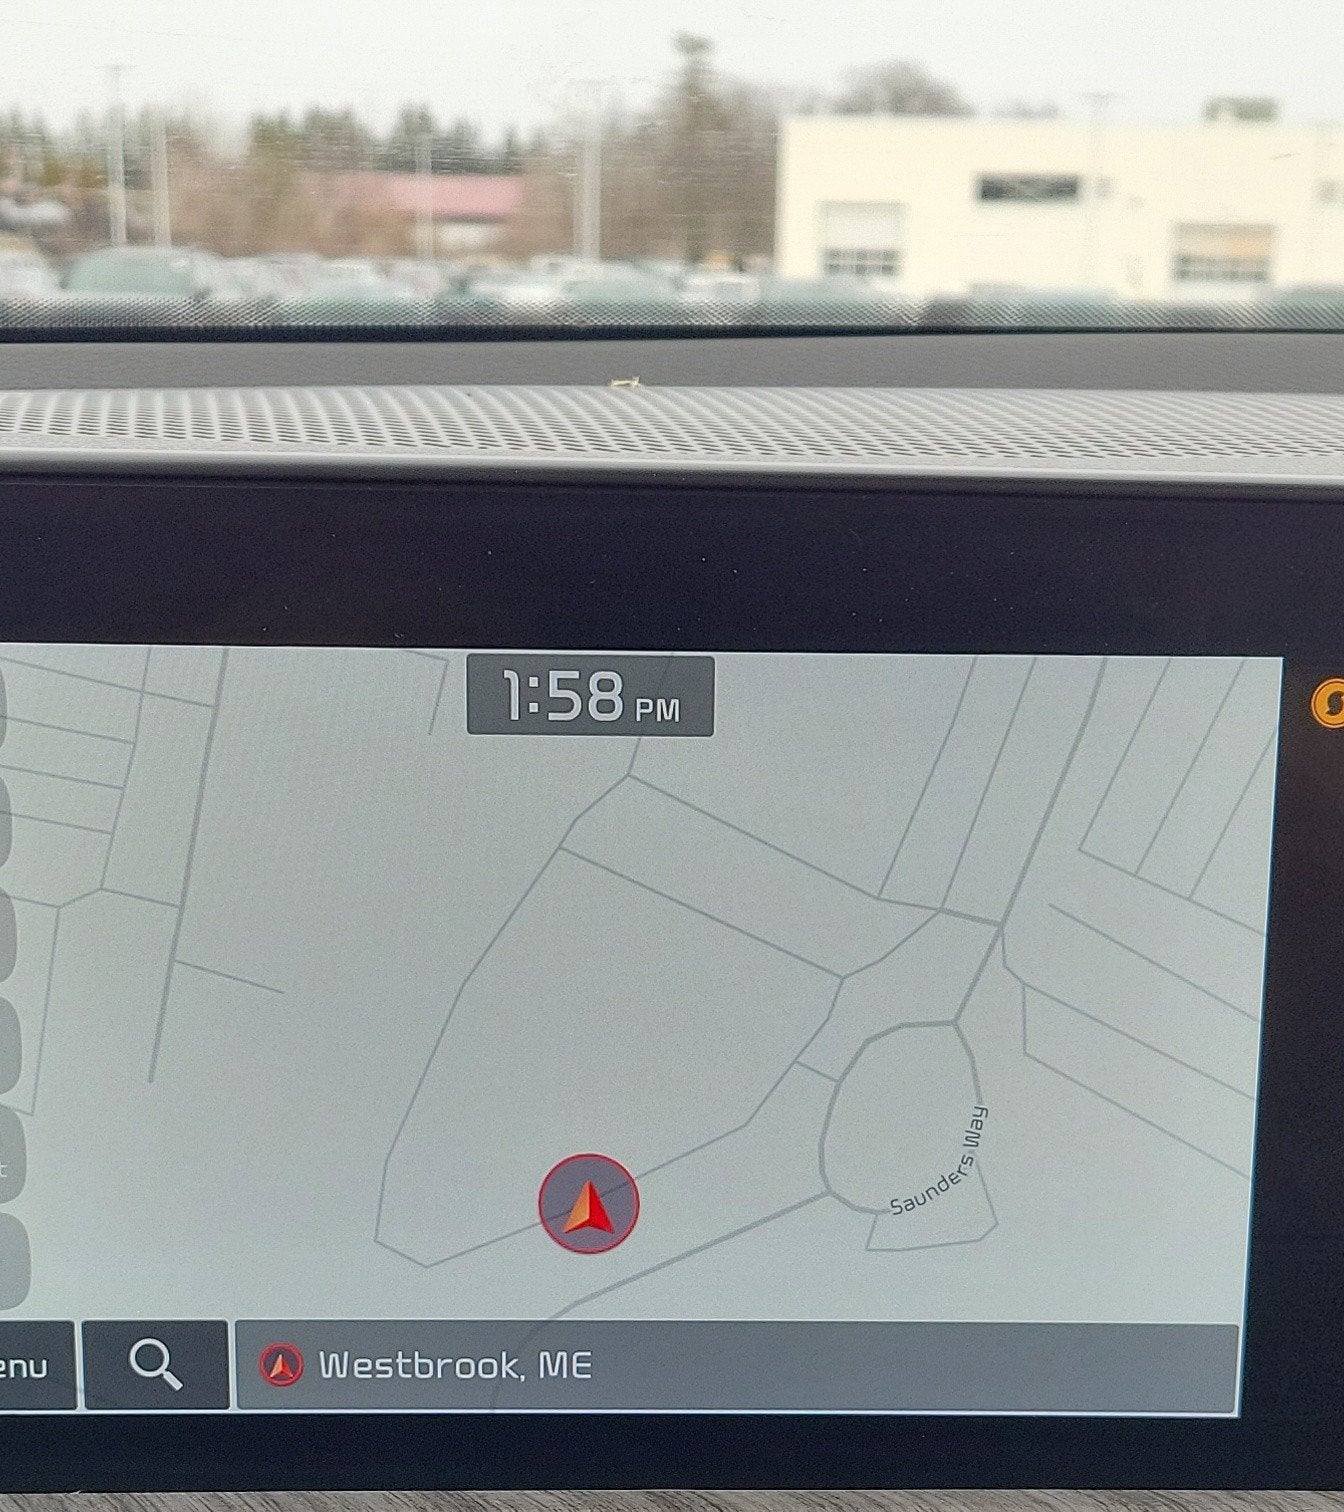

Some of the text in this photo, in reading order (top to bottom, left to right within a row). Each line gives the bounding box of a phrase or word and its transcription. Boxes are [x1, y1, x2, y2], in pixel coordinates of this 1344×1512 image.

[503, 669, 681, 724] 1:58 PM
[889, 1105, 989, 1216] Saunders Way
[318, 1349, 593, 1382] Westbrook, ME
